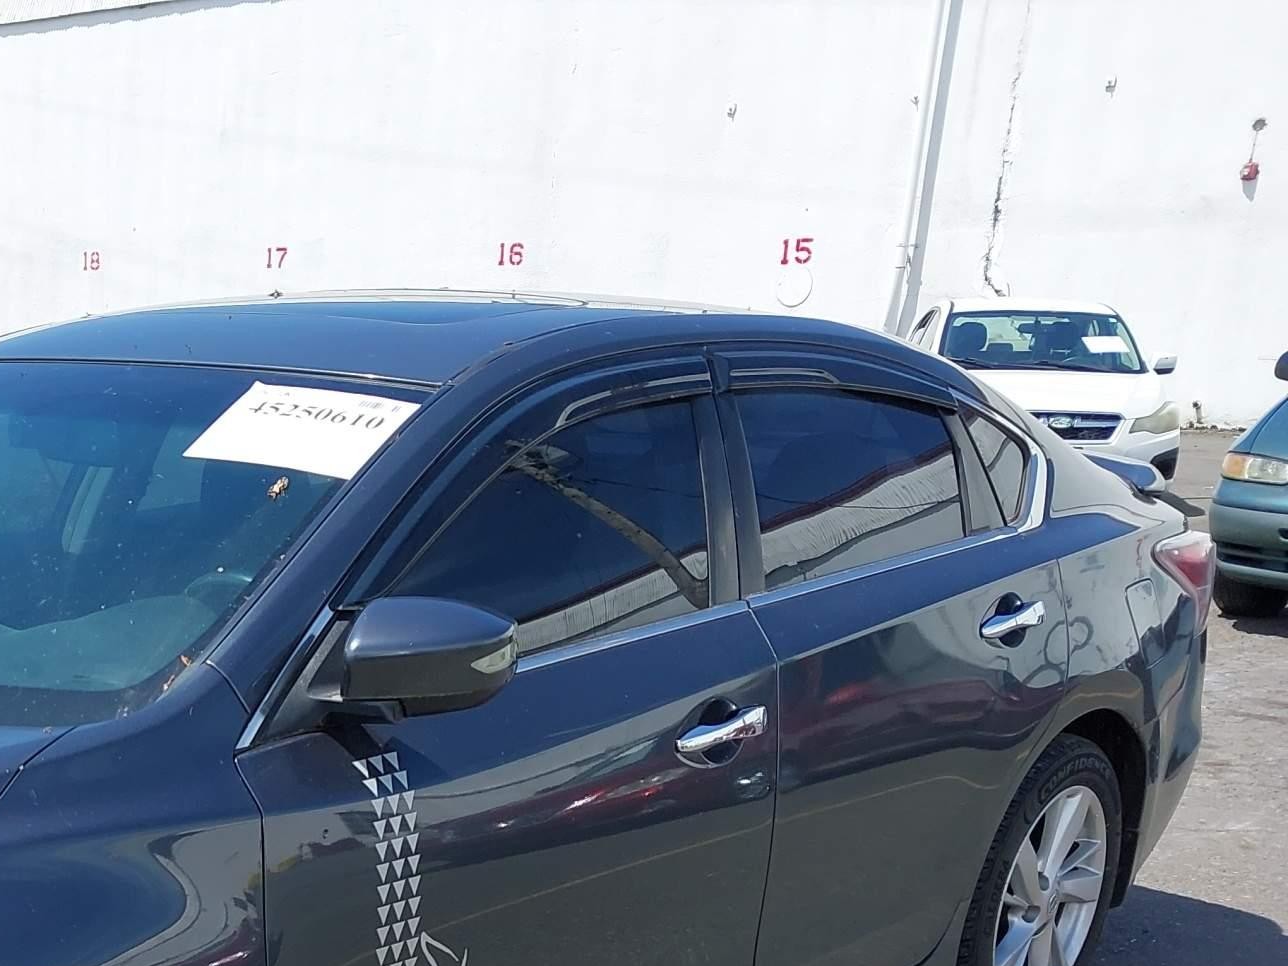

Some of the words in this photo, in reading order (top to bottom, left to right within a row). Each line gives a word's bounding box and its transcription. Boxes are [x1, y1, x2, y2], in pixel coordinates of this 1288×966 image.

[83, 251, 100, 271] 18
[266, 247, 288, 269] 17
[498, 243, 524, 266] 16
[780, 238, 814, 265] 15
[249, 401, 385, 430] 45250610
